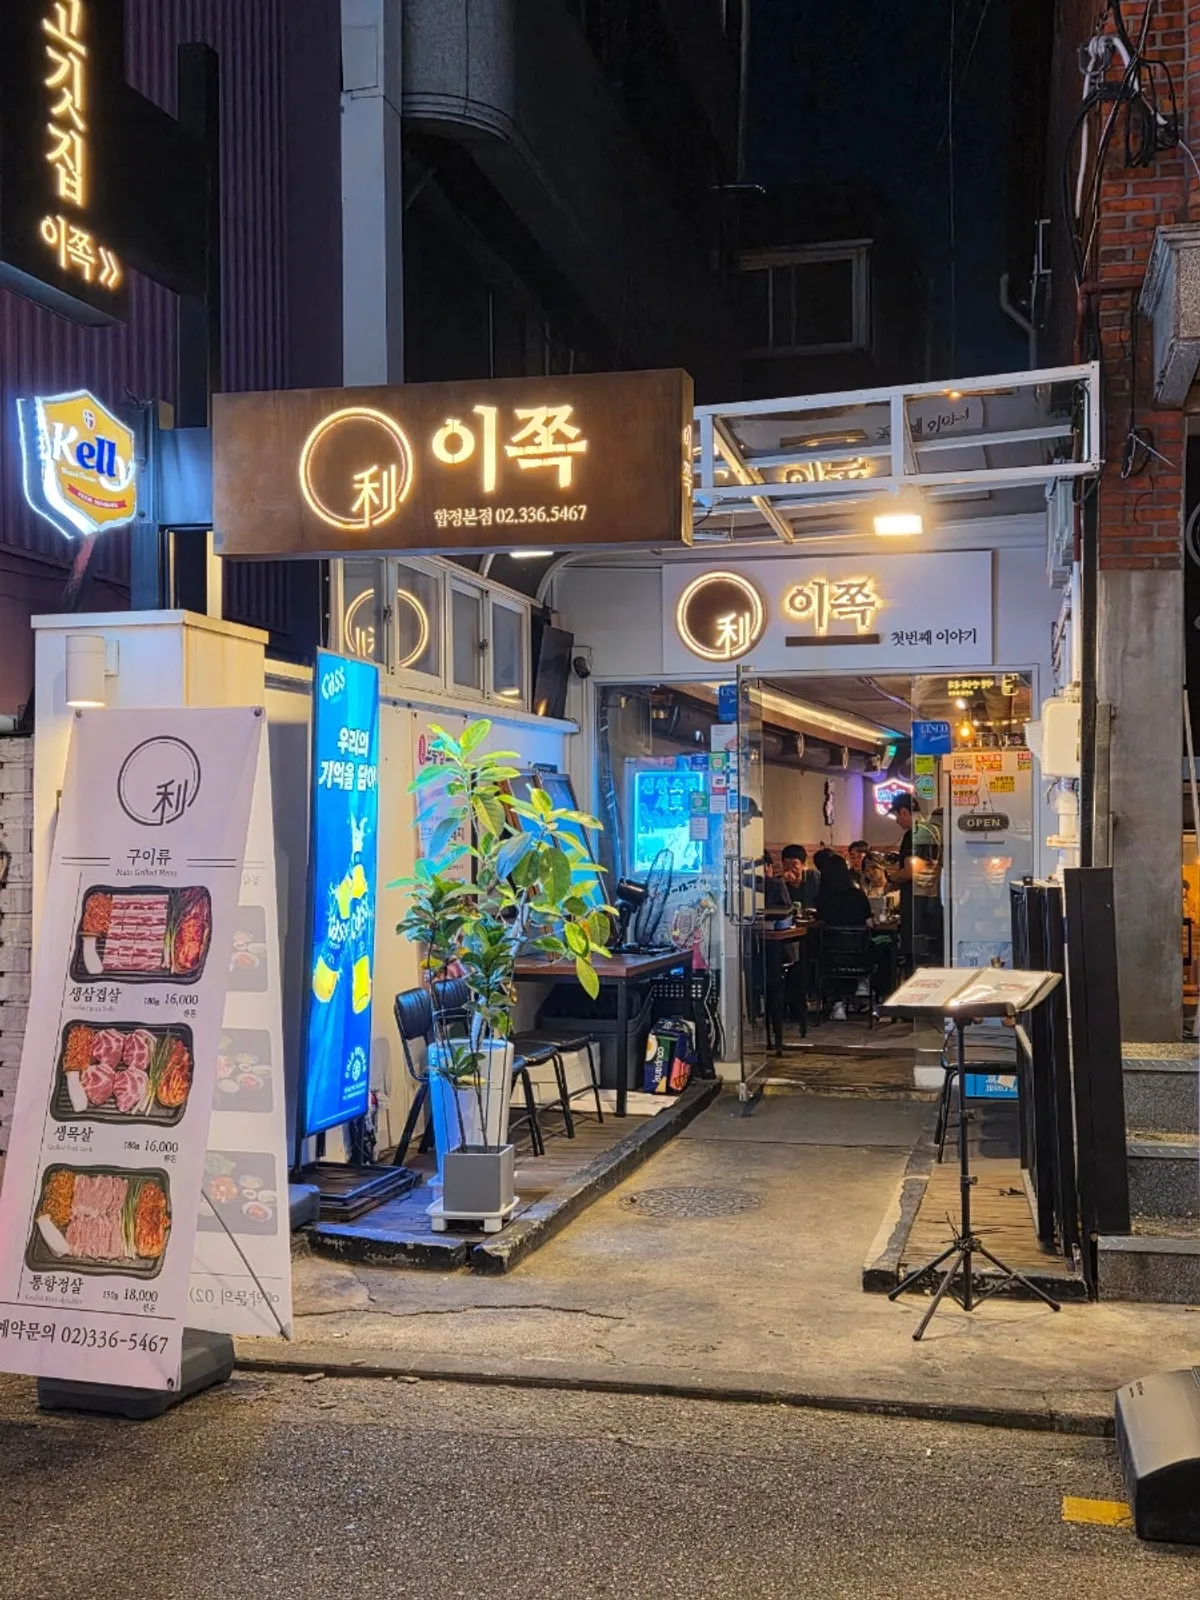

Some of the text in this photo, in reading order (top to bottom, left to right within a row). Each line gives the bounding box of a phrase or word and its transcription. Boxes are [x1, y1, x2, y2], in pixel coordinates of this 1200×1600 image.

[40, 215, 96, 282] 이쪽
[52, 422, 136, 492] Kelly
[431, 404, 588, 493] 이쪽
[434, 505, 588, 528] 합정본점 02.336.5467
[784, 577, 879, 634] 이쪽
[890, 627, 977, 646] 첫번째 이야기
[320, 666, 346, 700] Cass
[337, 727, 370, 758] 우리의
[318, 760, 355, 791] 기억을
[966, 817, 1001, 828] OPEN
[127, 848, 172, 866] 구이류
[69, 987, 122, 1004] 생삼겹살
[164, 994, 199, 1006] 16,000
[54, 1125, 94, 1142] 생목살
[145, 1140, 179, 1153] 16,000
[29, 1275, 84, 1295] 통항정살
[124, 1288, 159, 1302] 18,000
[61, 1326, 169, 1355] 02)336-5467
